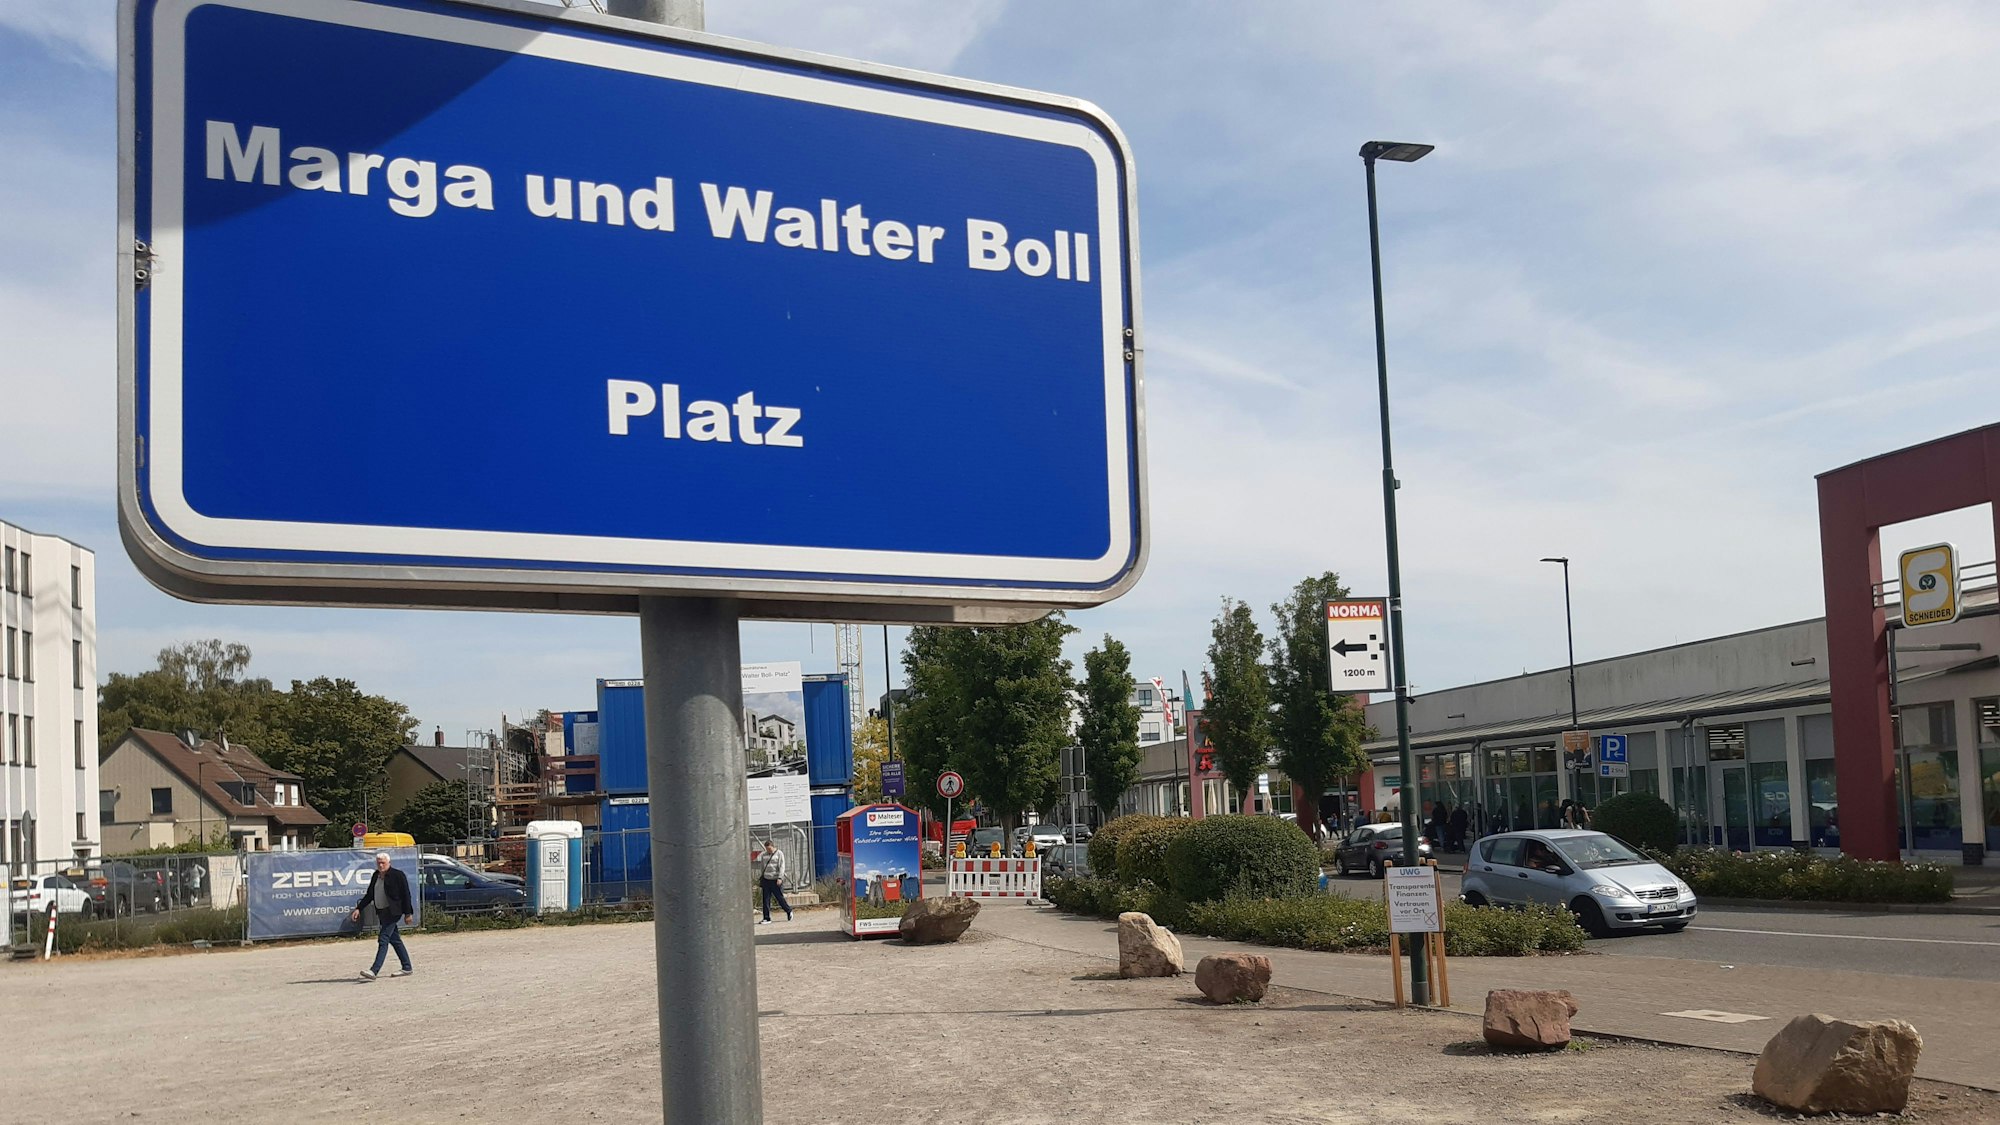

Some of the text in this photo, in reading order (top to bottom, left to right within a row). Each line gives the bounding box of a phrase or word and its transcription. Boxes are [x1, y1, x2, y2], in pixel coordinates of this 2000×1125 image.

[206, 120, 1090, 283] Marga und Walter Boll
[607, 379, 804, 448] Platz
[1329, 604, 1380, 618] NORMA
[1909, 608, 1951, 622] SCHNEIDER
[1343, 669, 1366, 677] 1200
[1606, 738, 1620, 759] P
[295, 891, 310, 899] UND
